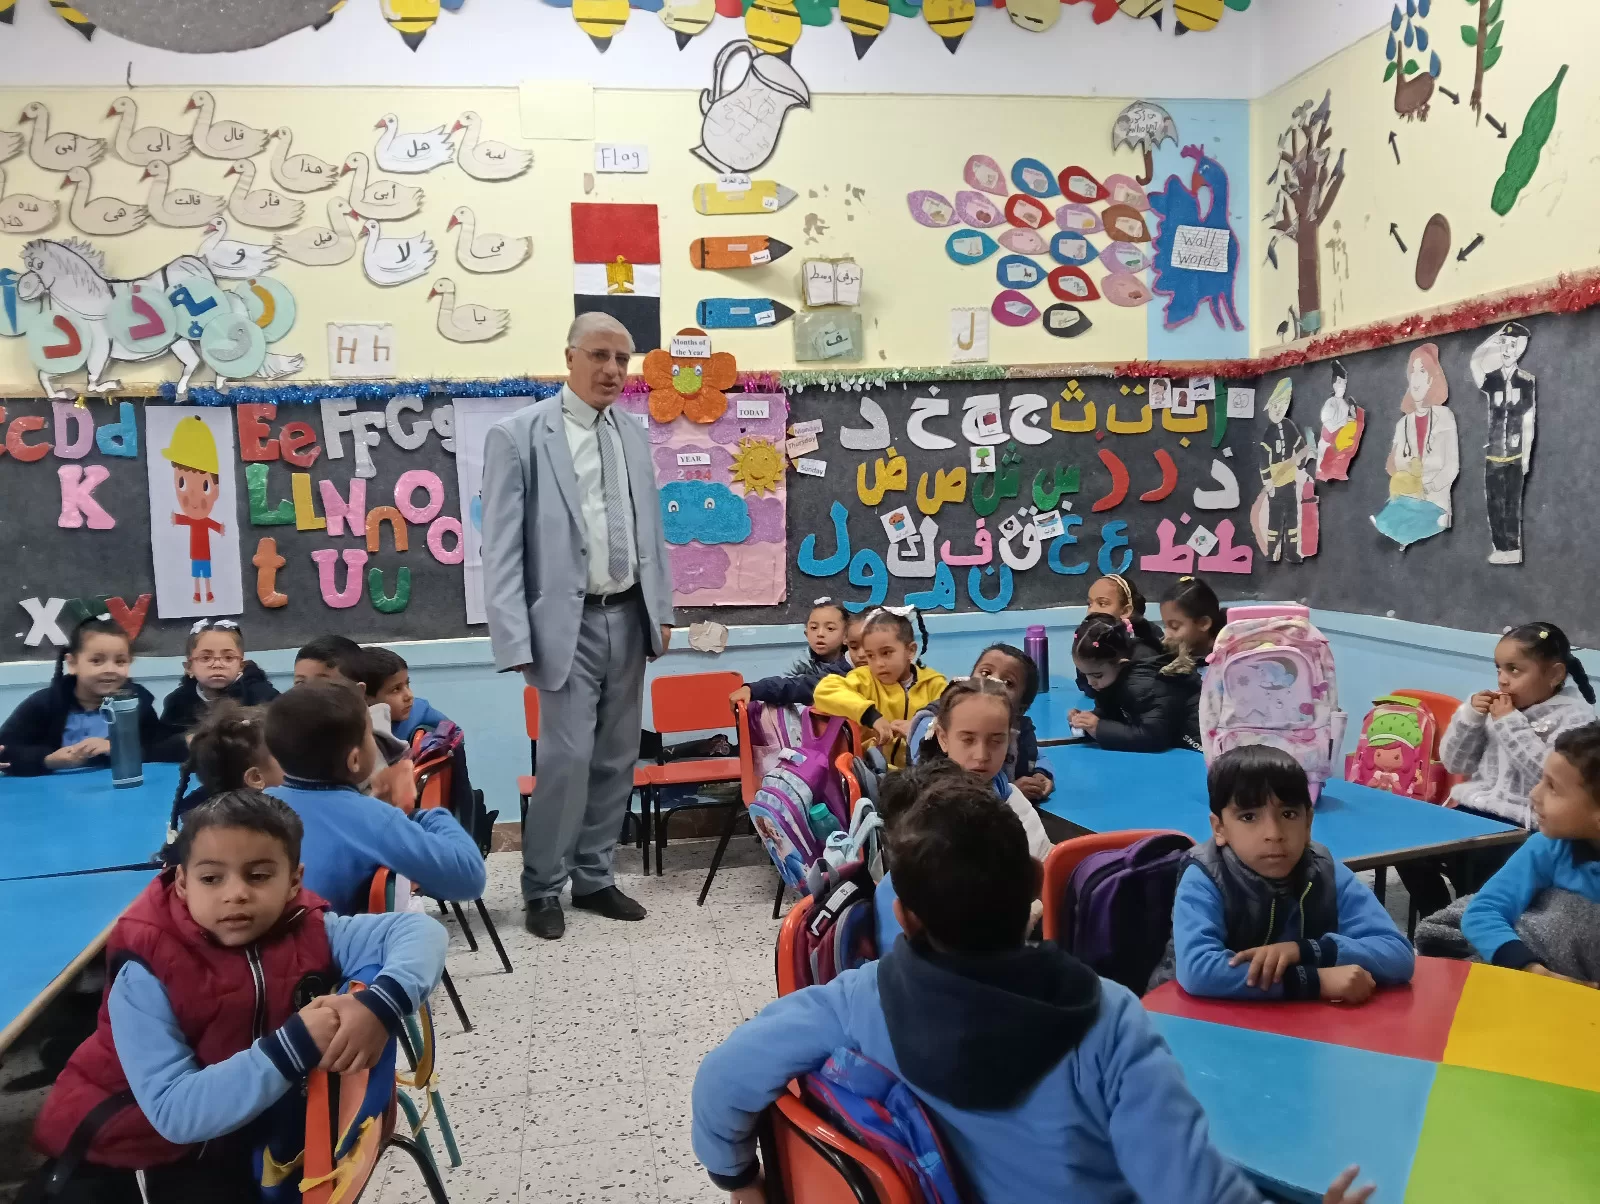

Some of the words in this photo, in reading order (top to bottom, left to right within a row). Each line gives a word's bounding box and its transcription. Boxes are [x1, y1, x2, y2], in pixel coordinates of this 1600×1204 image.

[300, 158, 323, 174] هذا
[407, 139, 430, 158] هل
[601, 147, 640, 169] Flag
[394, 240, 411, 264] لا
[672, 338, 698, 346] Months
[739, 409, 765, 417] TODAY
[794, 424, 821, 436] Monday
[907, 389, 957, 450] خ
[1009, 393, 1052, 445] ج
[1051, 379, 1098, 432] ث
[1106, 383, 1153, 434] ت
[787, 436, 817, 450] Thursday
[800, 465, 824, 476] Sunday
[857, 446, 907, 506] ض
[916, 466, 967, 516] ص
[972, 441, 1020, 517] ش
[1032, 461, 1081, 512] س
[57, 464, 116, 530] K
[797, 500, 851, 577] ل
[939, 517, 993, 567] ف
[1097, 519, 1134, 576] ع
[842, 547, 889, 614] و
[967, 563, 1014, 613] ن
